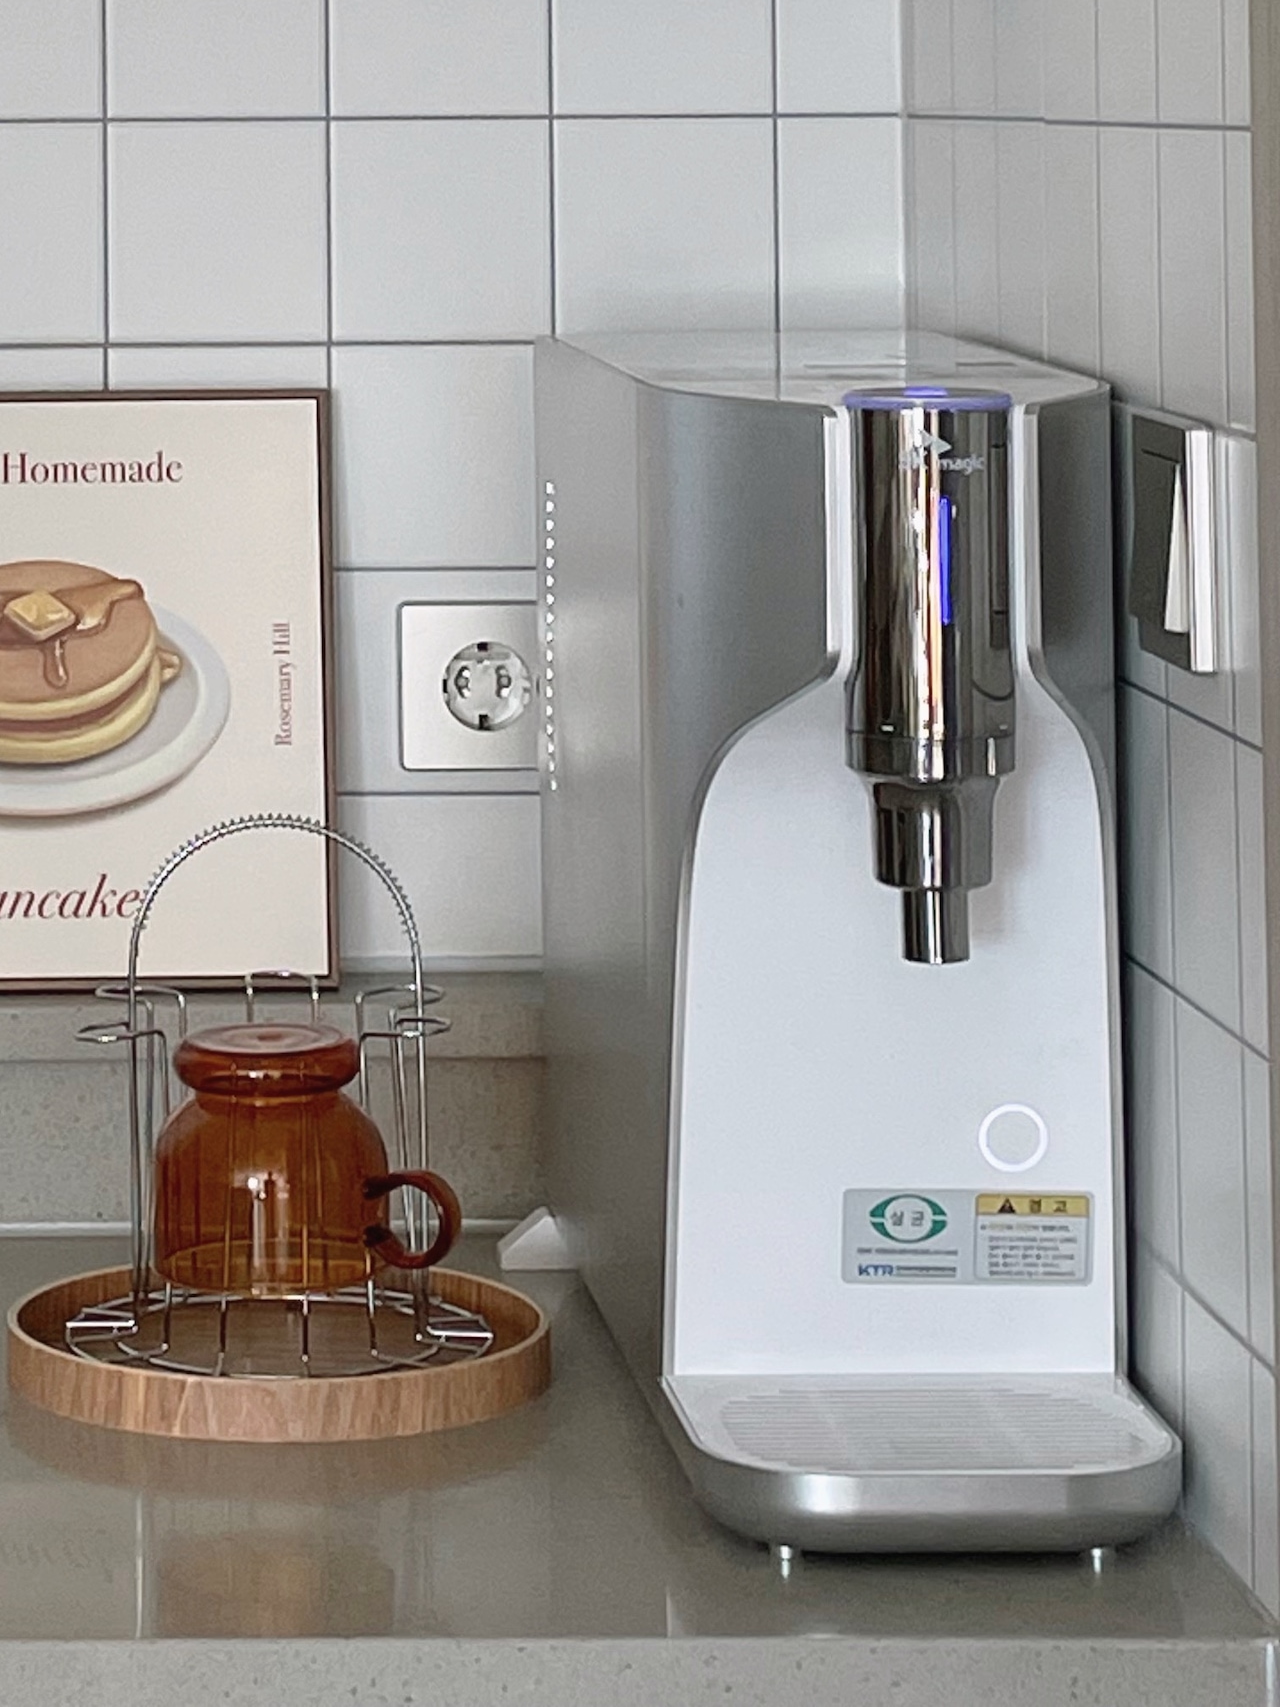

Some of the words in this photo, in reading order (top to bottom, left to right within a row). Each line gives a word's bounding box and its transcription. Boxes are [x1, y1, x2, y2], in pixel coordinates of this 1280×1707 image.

[1, 450, 184, 485] Homemade
[272, 622, 291, 655] Hill
[273, 659, 298, 746] Rosemary
[858, 1262, 894, 1277] KTR
